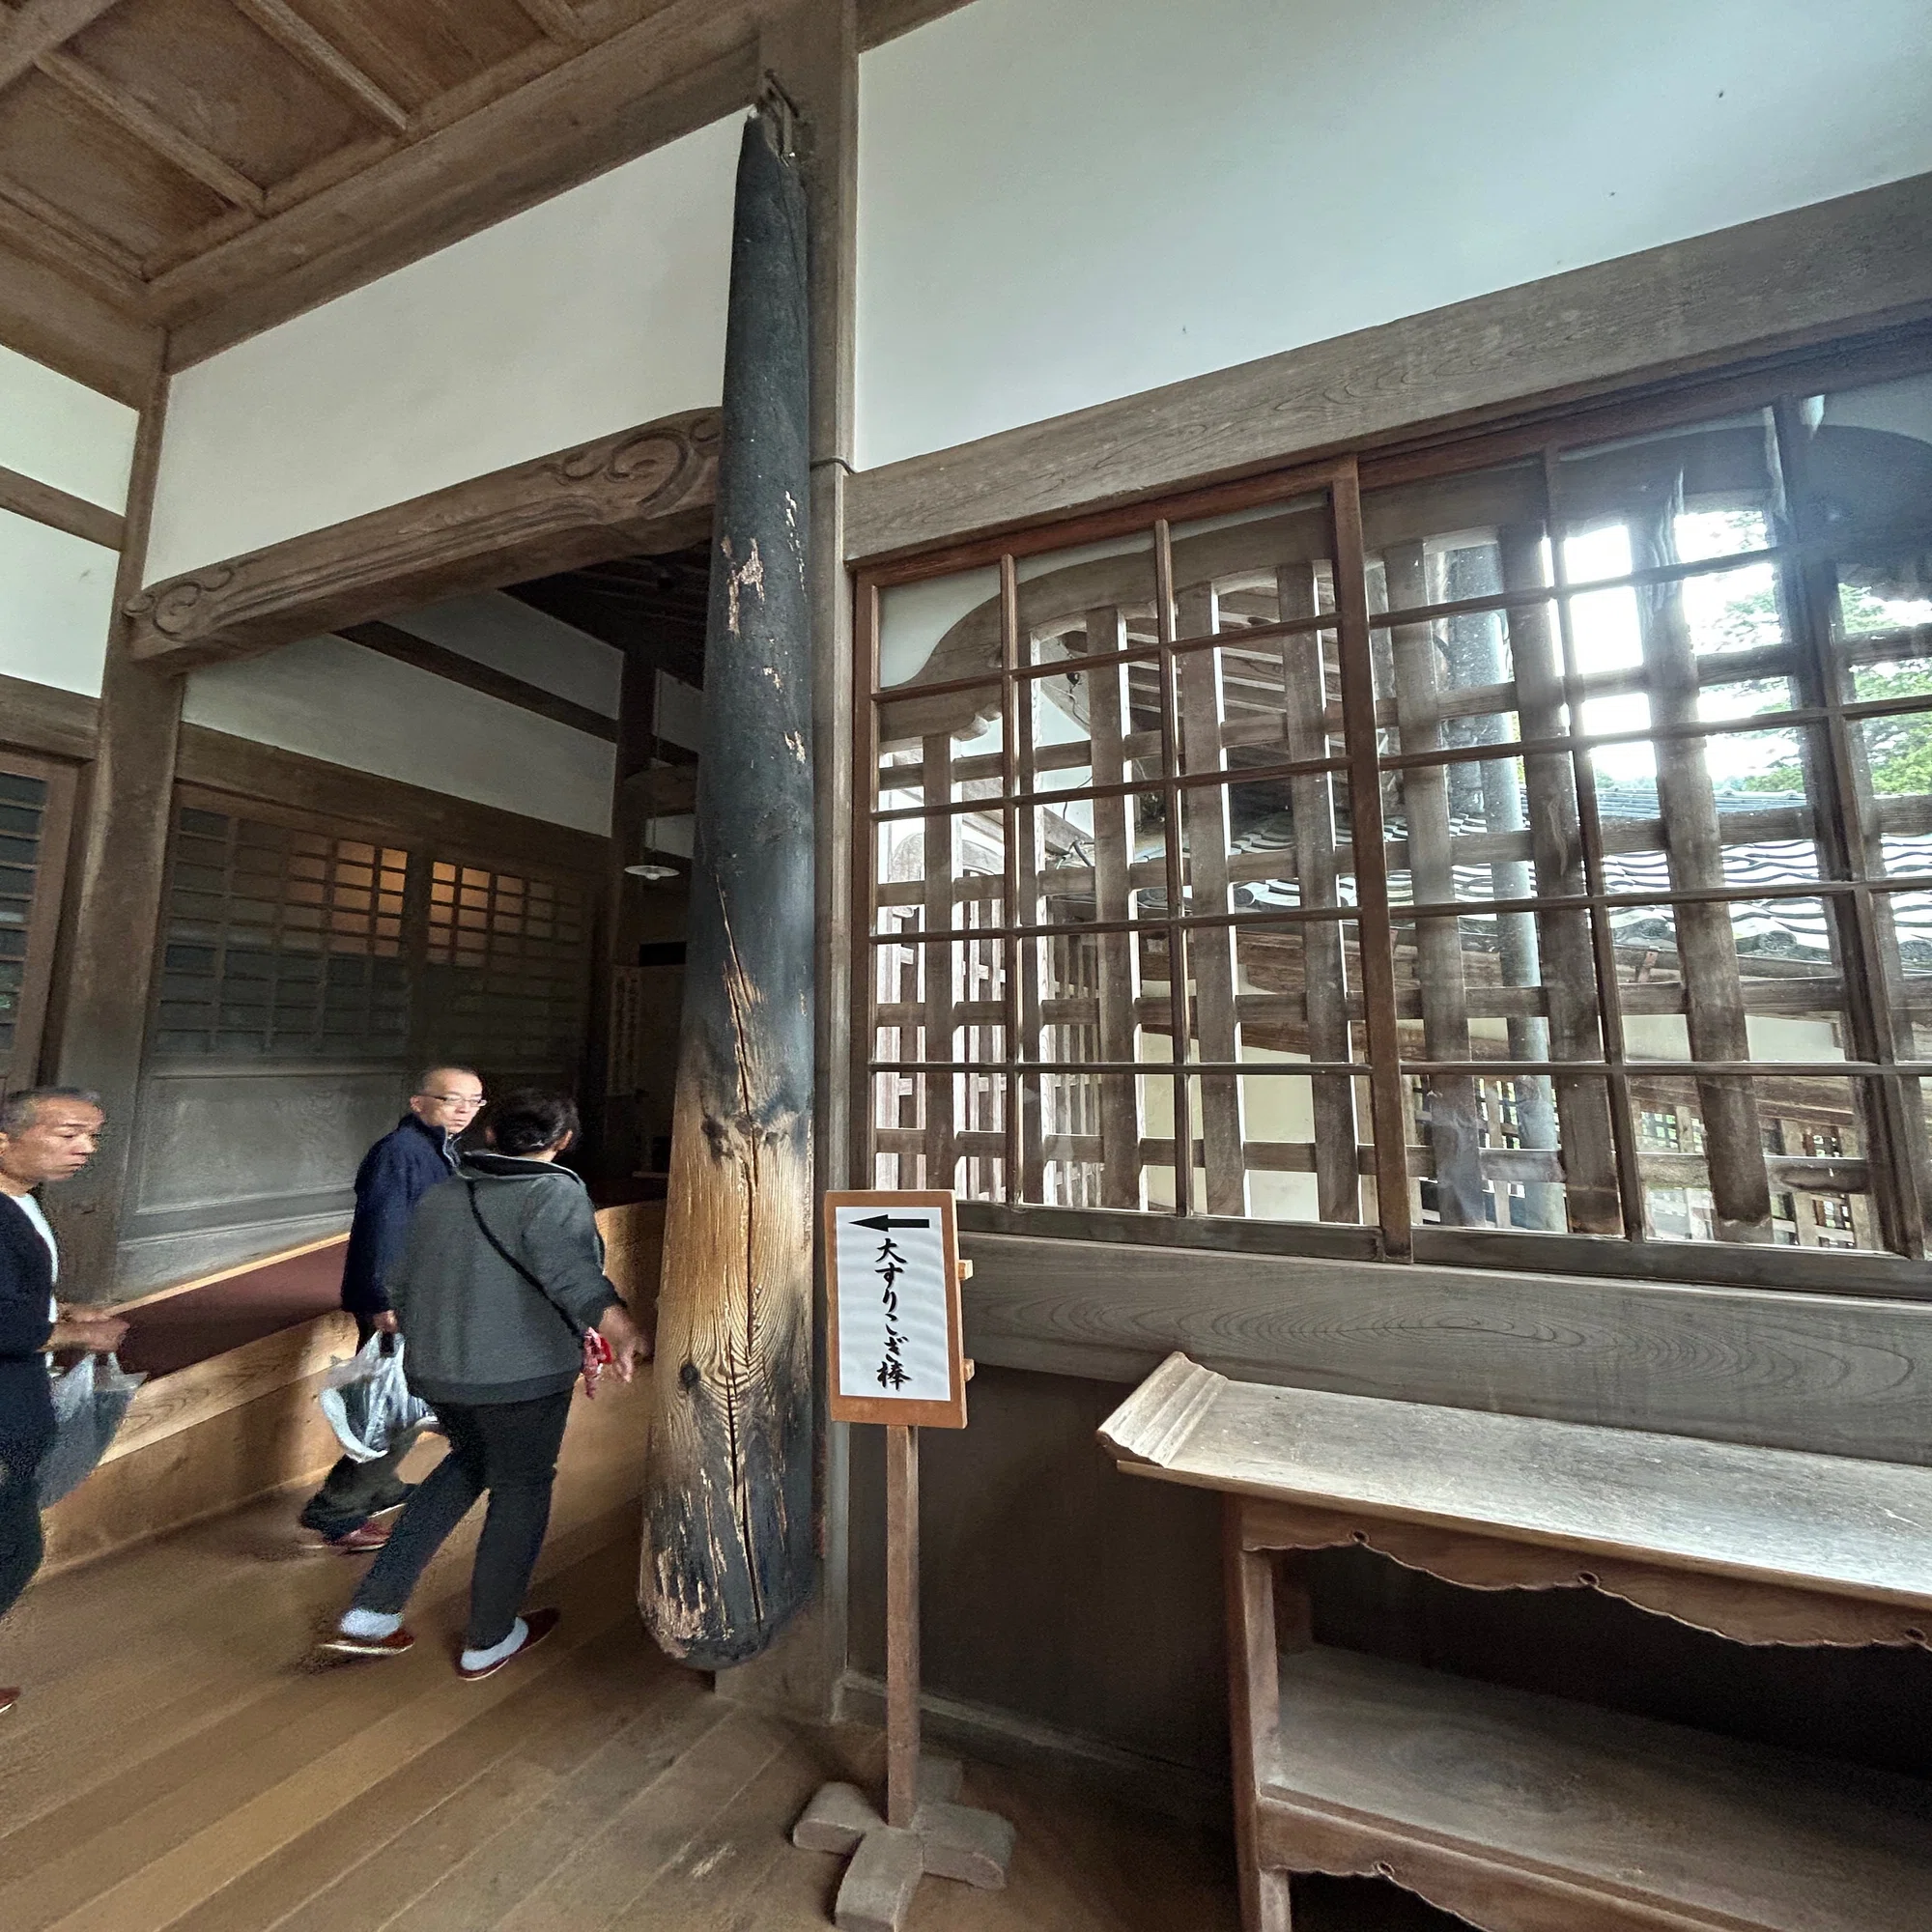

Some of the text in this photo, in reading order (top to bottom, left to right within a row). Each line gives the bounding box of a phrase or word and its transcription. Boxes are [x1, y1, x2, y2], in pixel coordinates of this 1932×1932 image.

[874, 1237, 911, 1390] 大すりこぎ棒
